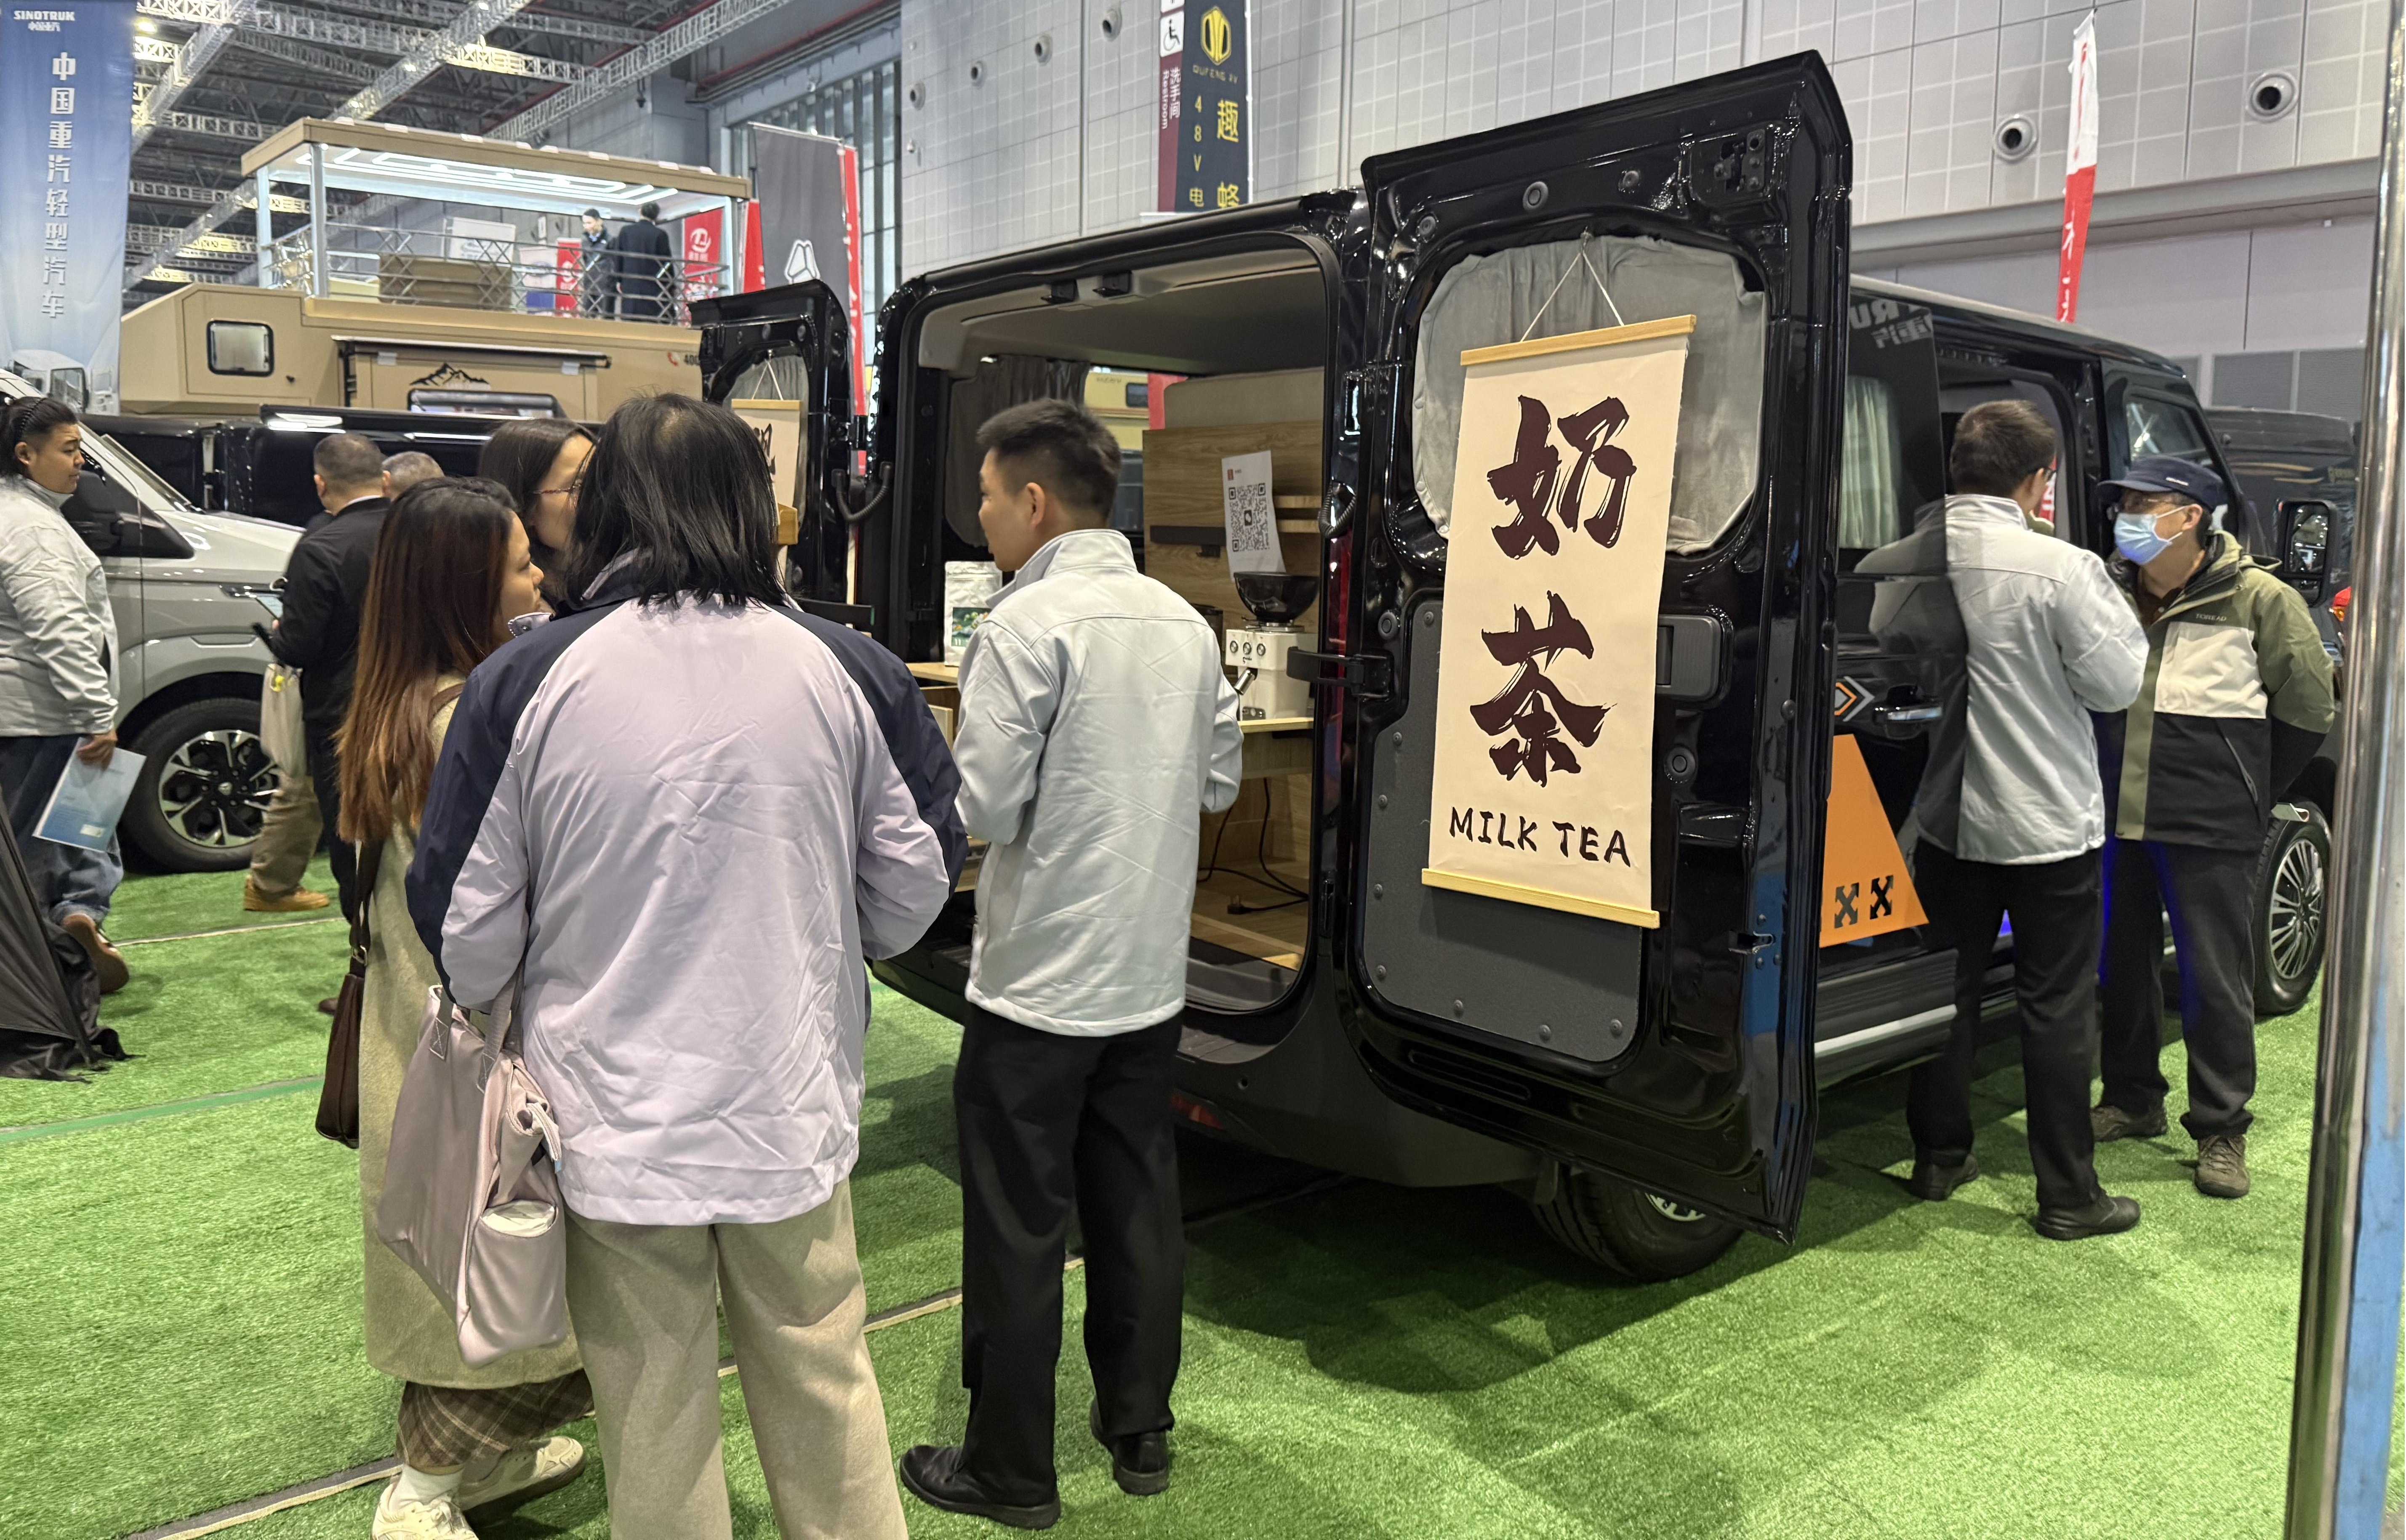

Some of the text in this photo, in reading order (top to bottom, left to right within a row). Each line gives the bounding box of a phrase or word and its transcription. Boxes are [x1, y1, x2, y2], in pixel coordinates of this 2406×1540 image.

[13, 11, 75, 21] SINOTRUK
[1161, 69, 1170, 129] Restroom
[1169, 66, 1181, 120] 洗手间
[41, 52, 76, 318] 中国重汽轻型汽车
[1469, 394, 1637, 788] 奶茶
[1449, 806, 1631, 867] MILK TEA
